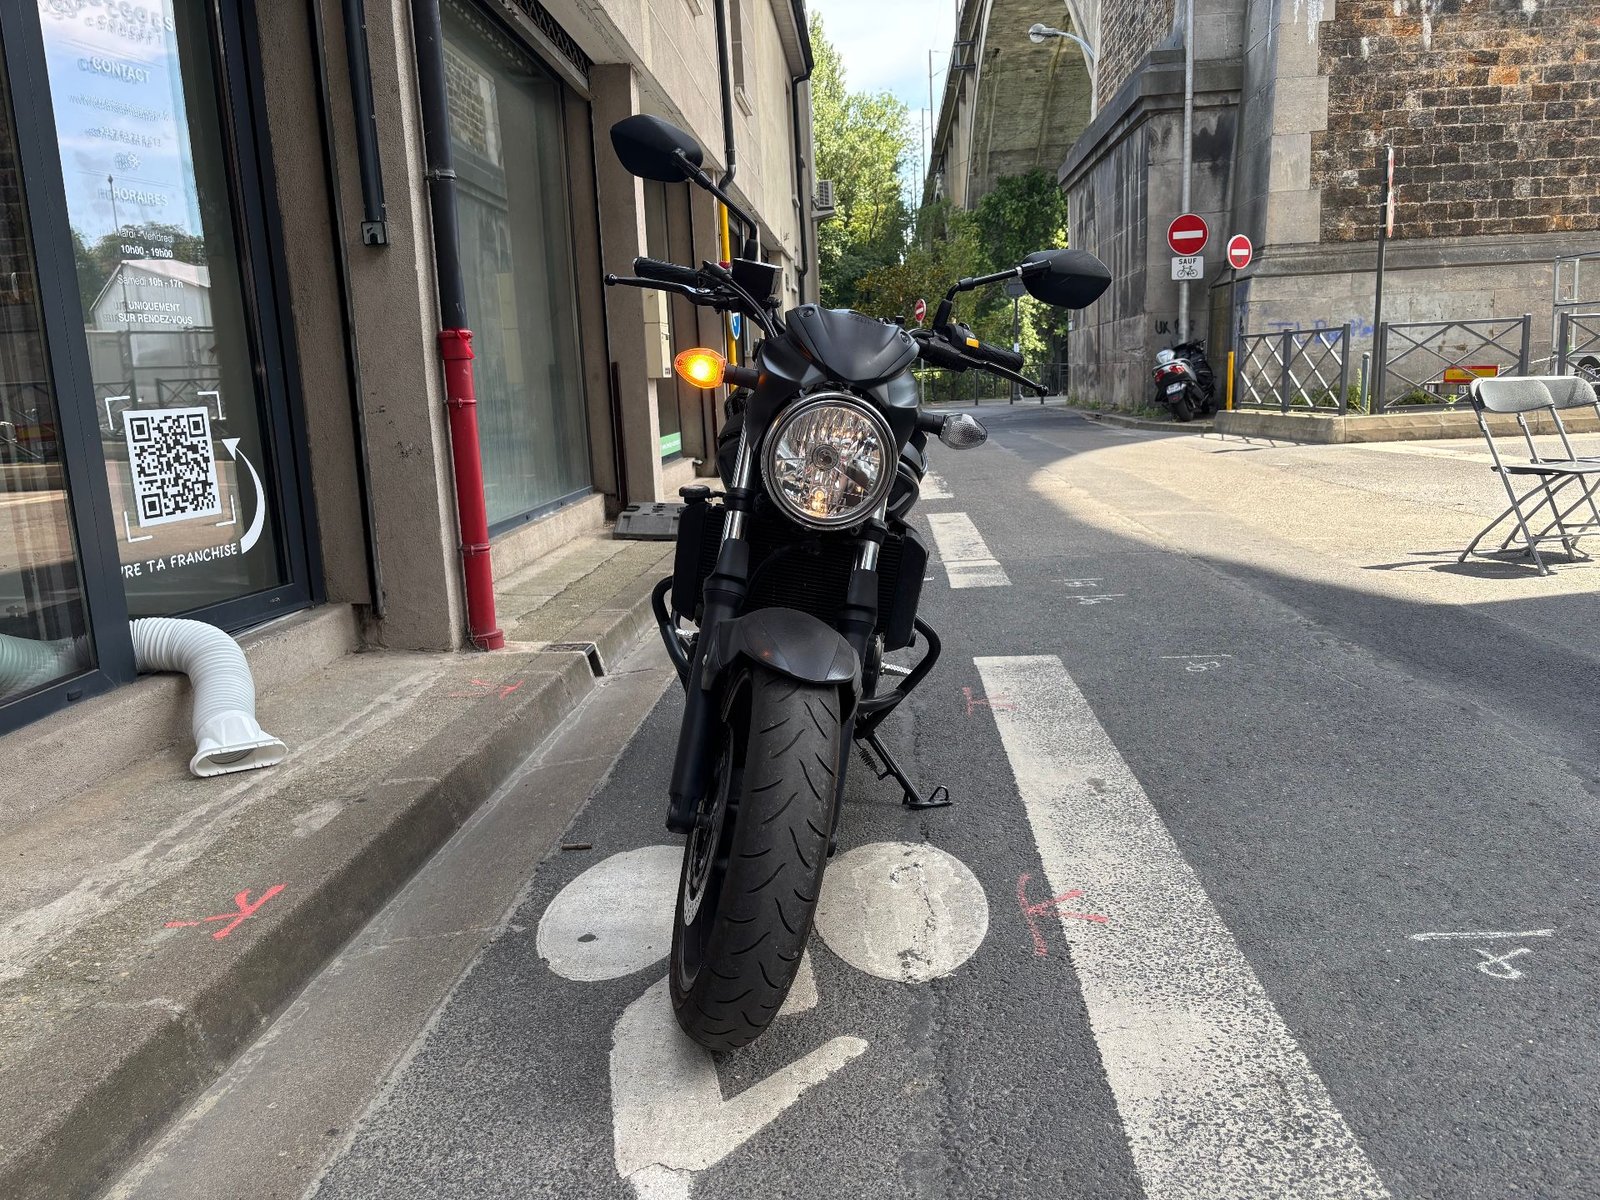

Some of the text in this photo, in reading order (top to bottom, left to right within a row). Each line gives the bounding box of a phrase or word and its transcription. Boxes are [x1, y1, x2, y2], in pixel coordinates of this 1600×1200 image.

[92, 57, 150, 82] CONTACT
[113, 188, 168, 206] HORAIRES
[116, 228, 136, 239] ardi
[142, 231, 174, 243] Vendredi
[121, 245, 144, 255] 10h00
[150, 248, 173, 258] 19h00
[1178, 257, 1197, 265] SAUF
[117, 274, 147, 287] Samedi
[148, 277, 163, 287] 10h
[170, 279, 184, 289] 17h
[128, 301, 180, 312] UNIQUEMENT
[118, 314, 193, 325] SUR RENDEZ-VOUS
[146, 558, 166, 573] TA
[170, 543, 238, 568] FRANCHISE
